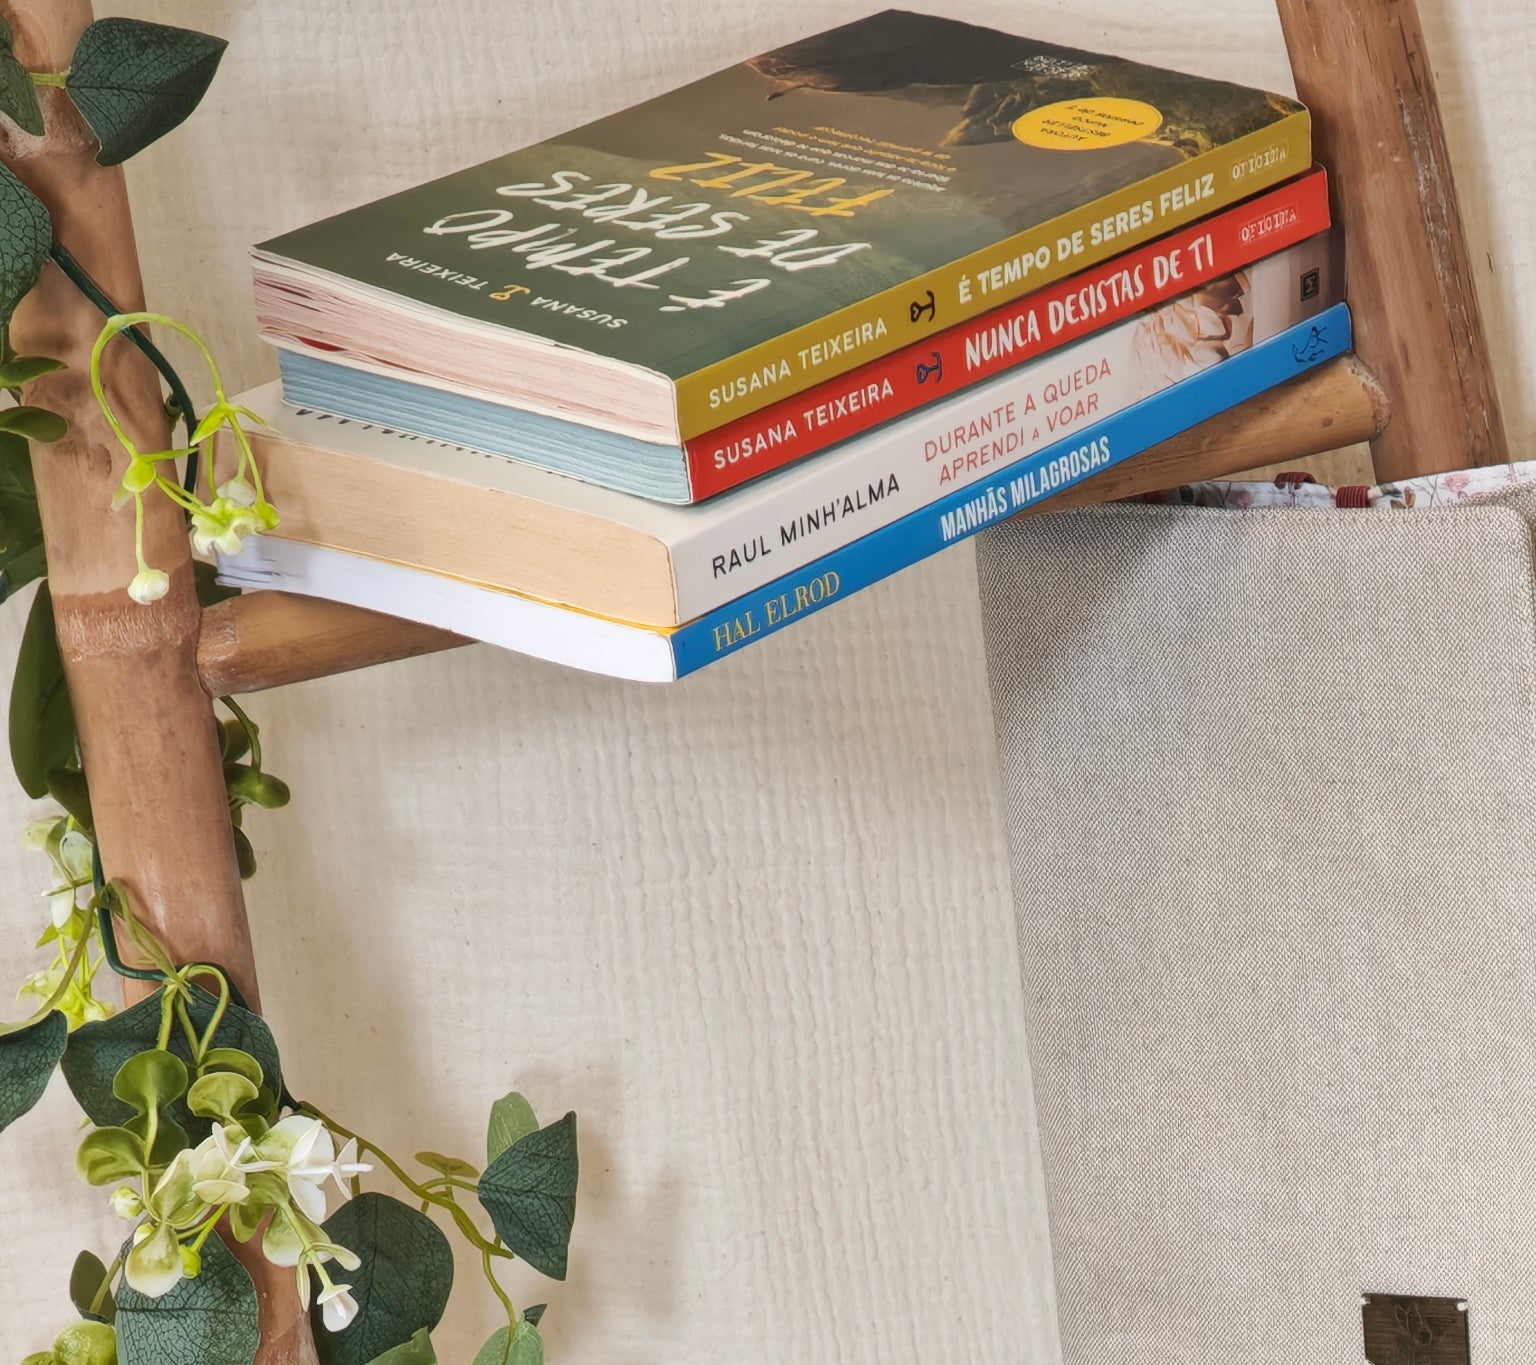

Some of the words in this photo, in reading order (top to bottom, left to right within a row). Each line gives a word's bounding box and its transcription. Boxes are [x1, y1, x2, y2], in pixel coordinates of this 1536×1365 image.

[496, 171, 749, 239] SERES
[649, 152, 895, 217] FELIZ
[386, 252, 489, 290] TEIXEIRA
[423, 209, 690, 290] TEMPO
[717, 229, 871, 271] DE
[959, 274, 972, 304] É
[977, 245, 1051, 296] TEMPO
[1056, 230, 1084, 262] DE
[1090, 201, 1154, 247] SERES
[1160, 173, 1215, 217] FELIZ
[531, 296, 628, 329] SUSANA
[660, 278, 771, 312] É
[709, 358, 791, 409] SUSANA
[798, 317, 888, 371] TEIXEIRA
[714, 419, 797, 470] SUSANA
[803, 378, 894, 431] TEIXEIRA
[965, 309, 1041, 371] NUNCA
[1048, 263, 1145, 335] DESISTAS
[1153, 243, 1183, 289] DE
[1188, 233, 1214, 274] TI
[923, 400, 1015, 463] DURANTE
[1024, 393, 1037, 416] A
[1043, 357, 1112, 407] QUEDA
[938, 431, 1024, 487] APRENDI
[1032, 426, 1041, 441] A
[1047, 392, 1100, 433] VOAR
[712, 535, 772, 580] RAUL
[780, 472, 901, 548] MINH'ALMA
[713, 612, 761, 653] HAL
[766, 570, 841, 627] ELROD
[940, 486, 1008, 543] MANHÃS
[1010, 435, 1111, 501] MILAGROSAS
